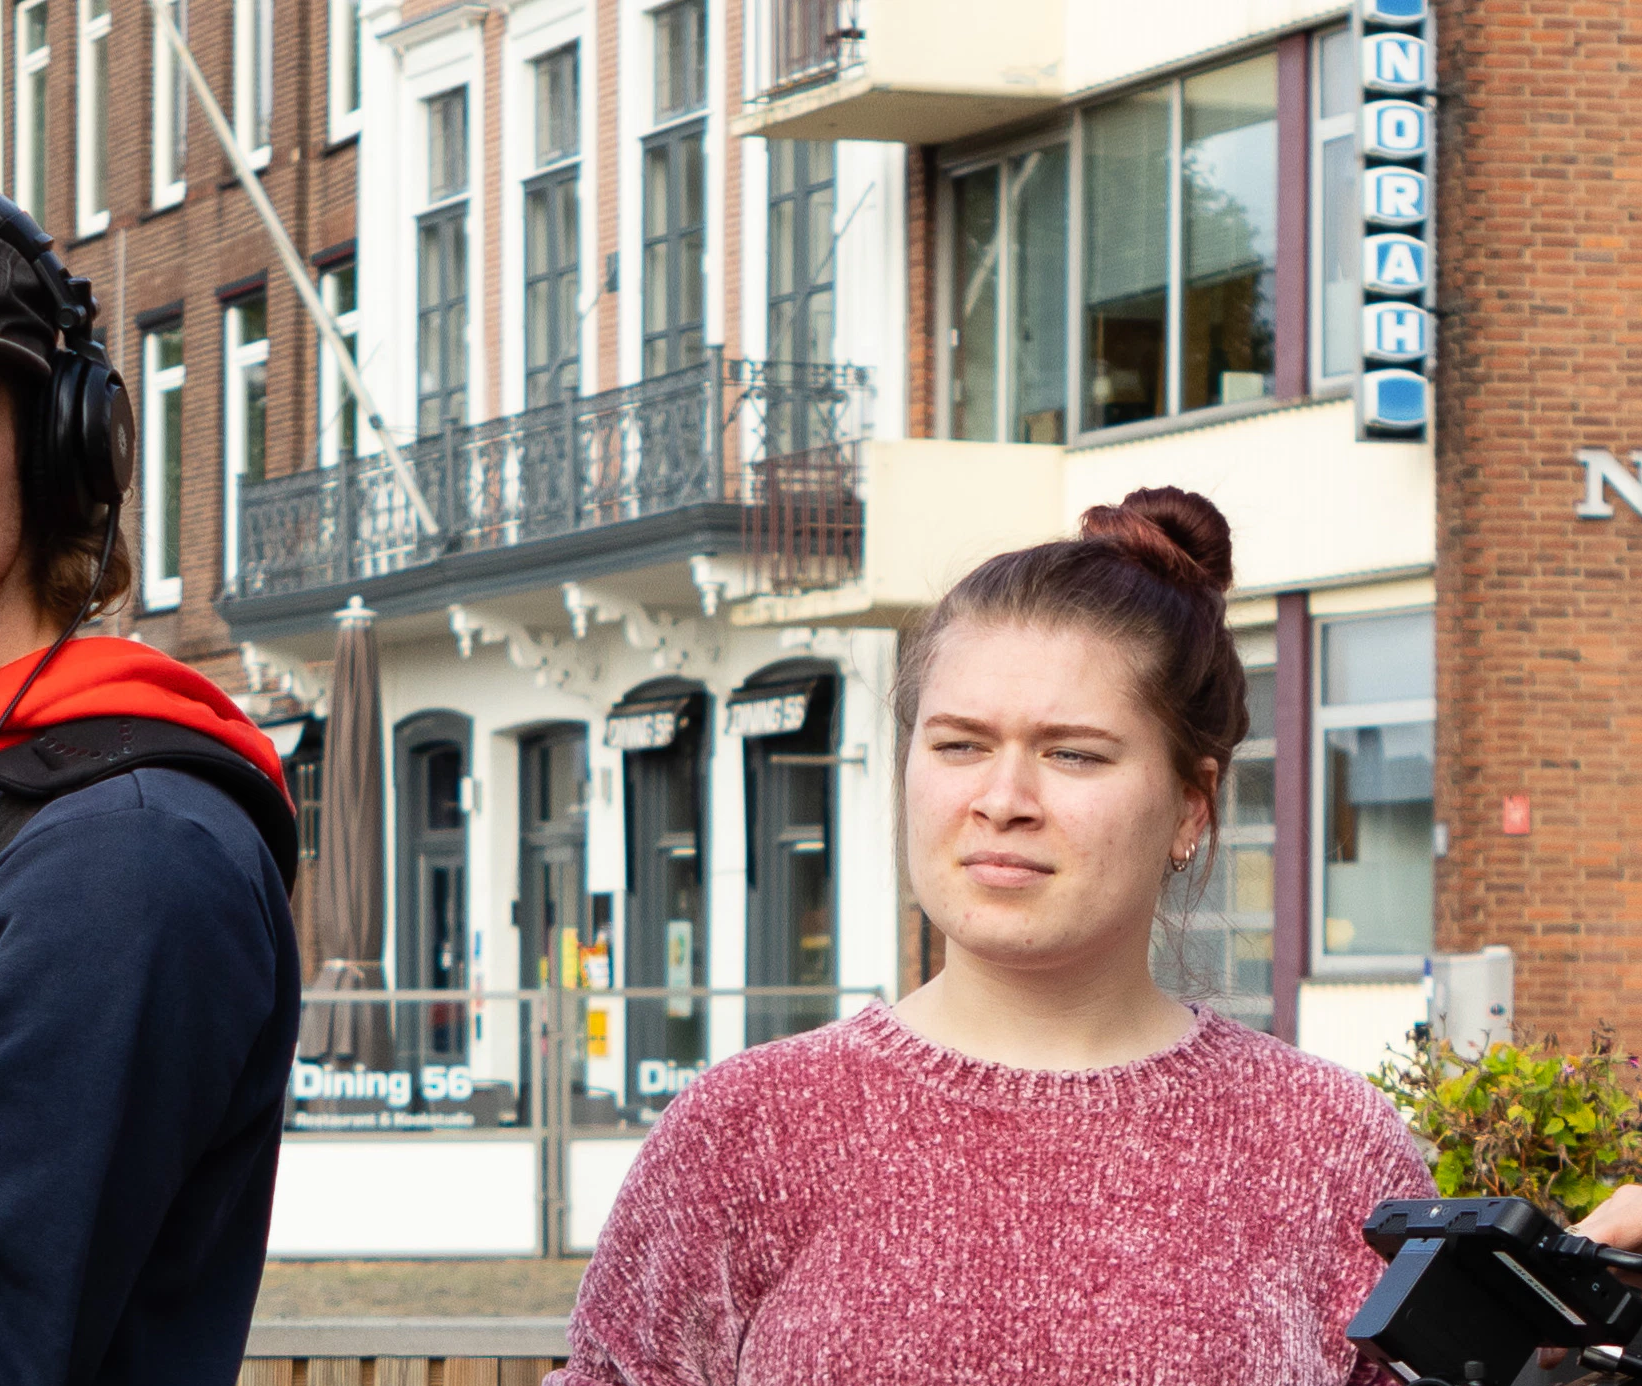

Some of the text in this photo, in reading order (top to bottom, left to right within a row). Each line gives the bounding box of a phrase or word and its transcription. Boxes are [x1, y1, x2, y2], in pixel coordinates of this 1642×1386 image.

[1376, 39, 1422, 353] NORAH
[293, 1063, 473, 1107] Dining 56
